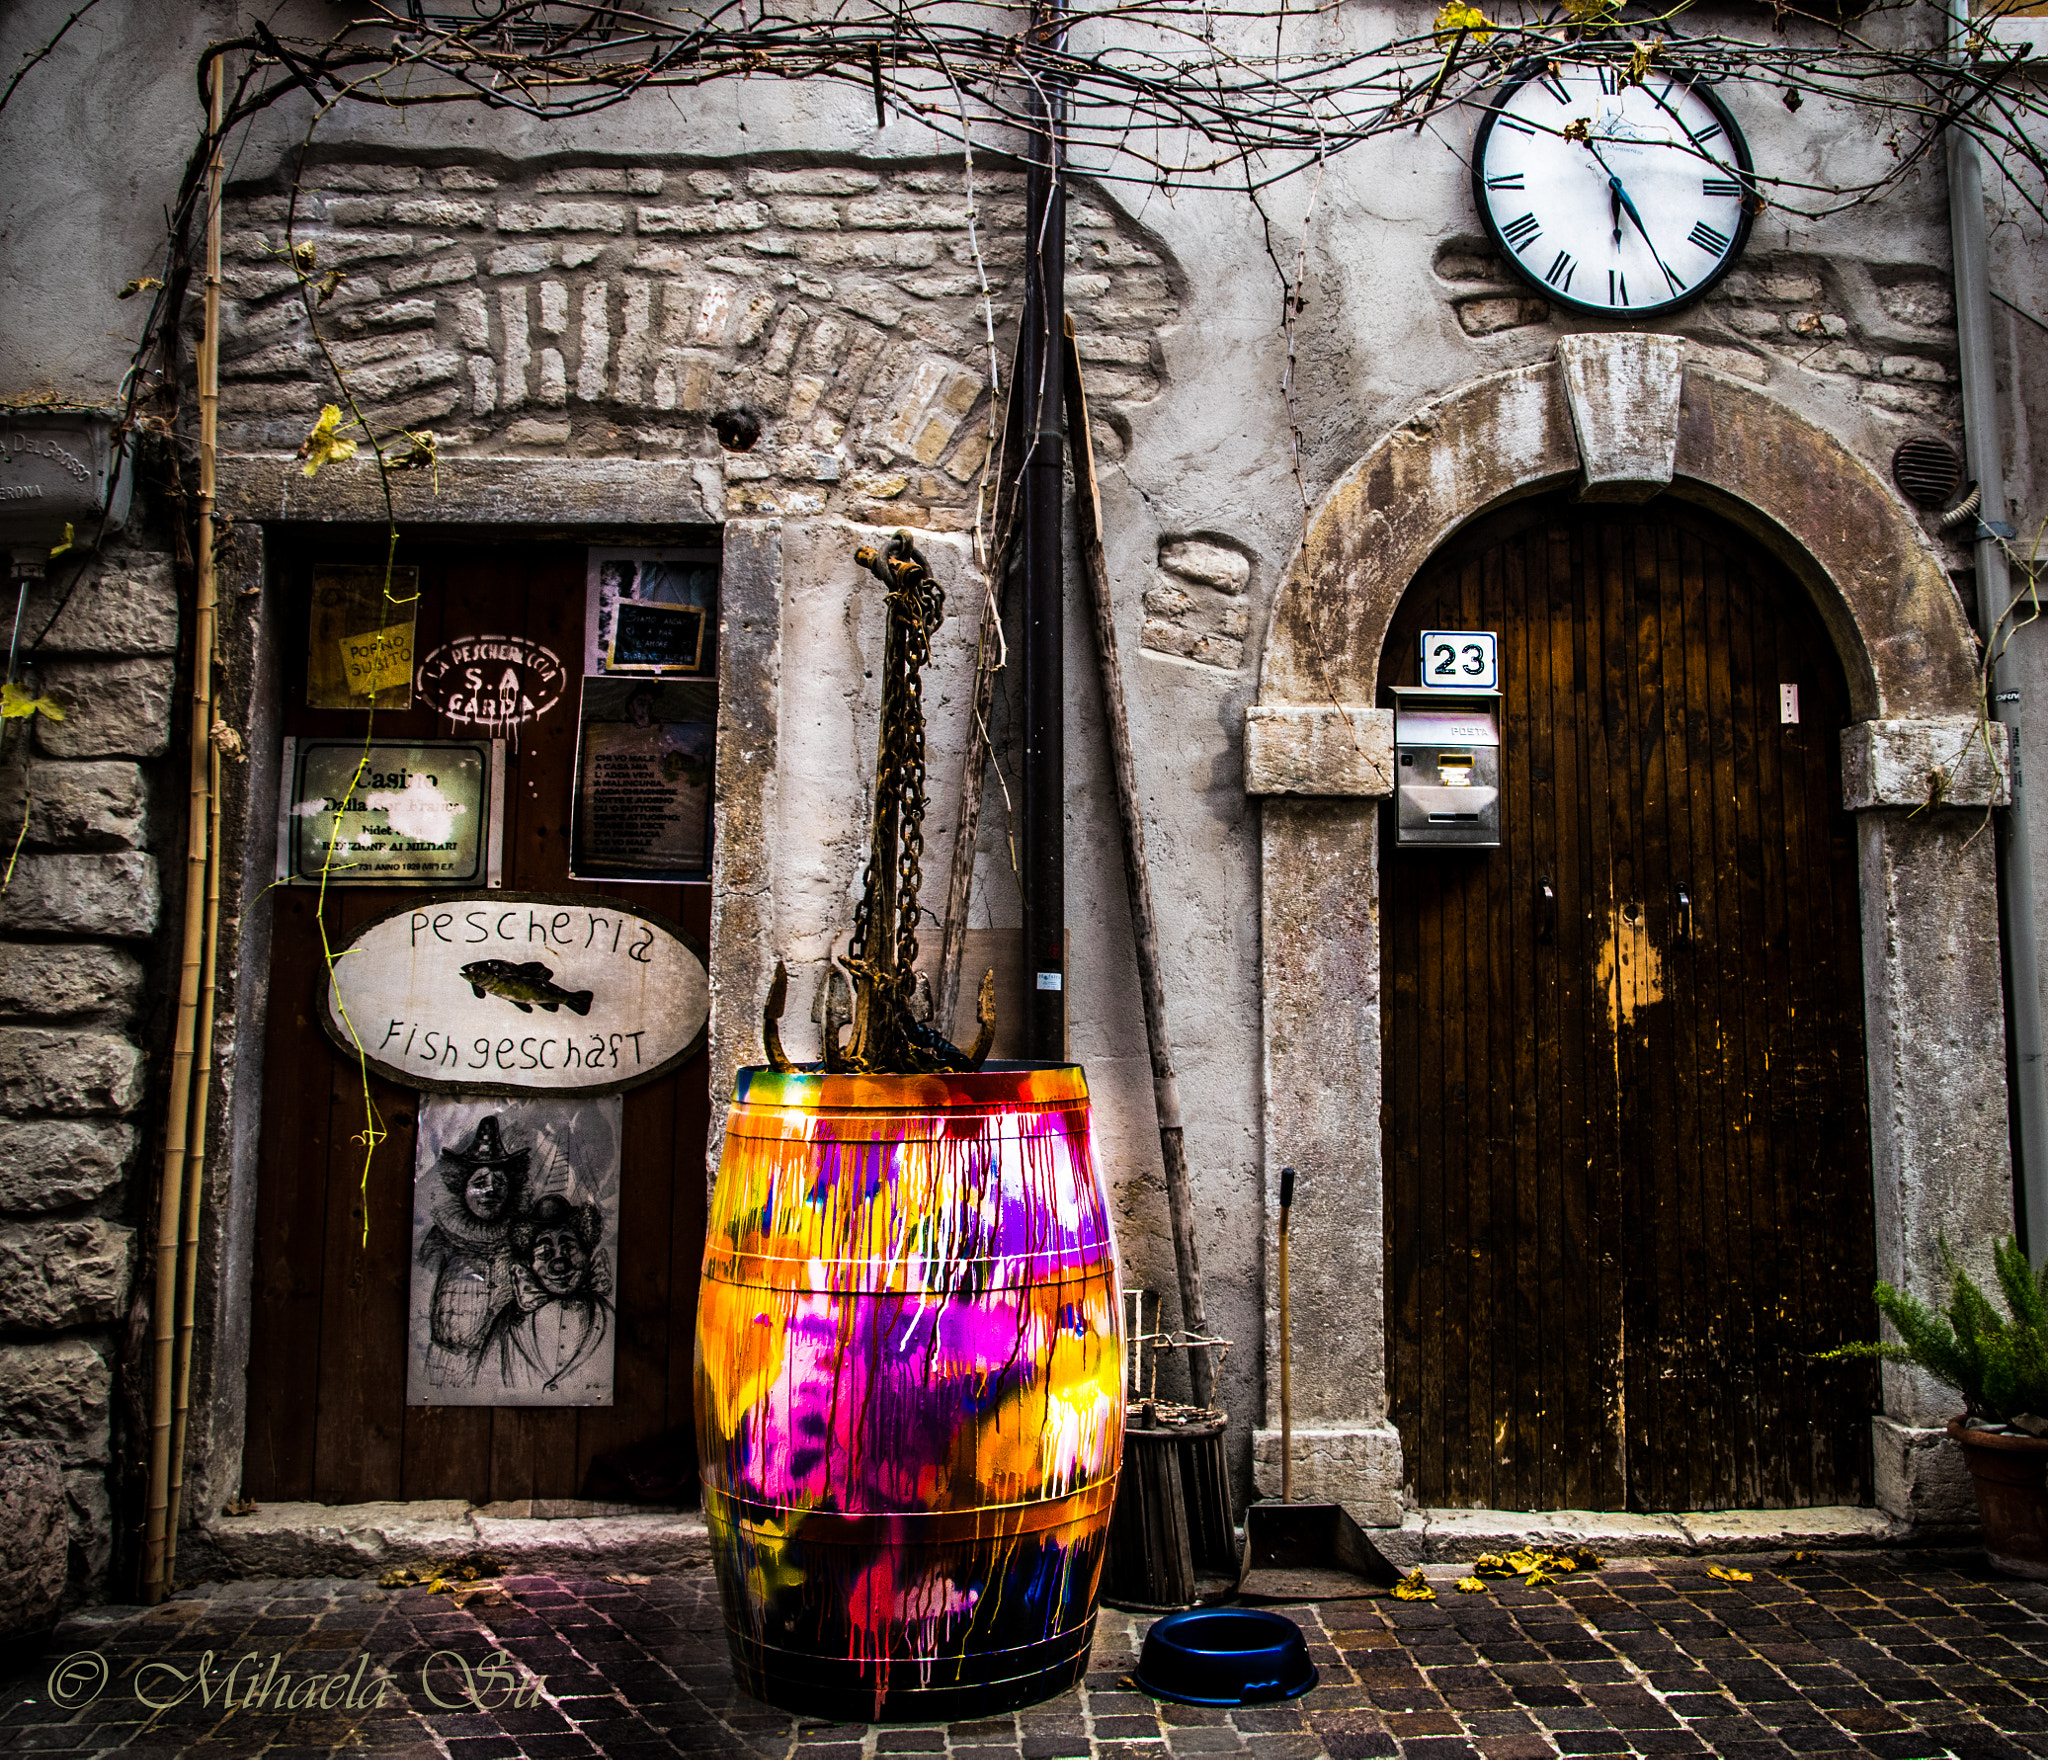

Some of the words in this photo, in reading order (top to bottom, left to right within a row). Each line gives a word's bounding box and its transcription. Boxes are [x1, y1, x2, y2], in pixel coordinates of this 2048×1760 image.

[1703, 179, 1741, 196] III
[1608, 270, 1629, 307] VI
[0, 485, 43, 501] ERONA
[351, 648, 412, 677] SUBITO
[1433, 644, 1485, 676] 23
[448, 693, 535, 717] GARDA
[1450, 727, 1489, 736] POSTA
[322, 797, 368, 813] Dalla
[388, 841, 404, 852] AI
[405, 841, 458, 852] MILITARI
[359, 863, 373, 871] 731
[374, 863, 400, 871] ANNO
